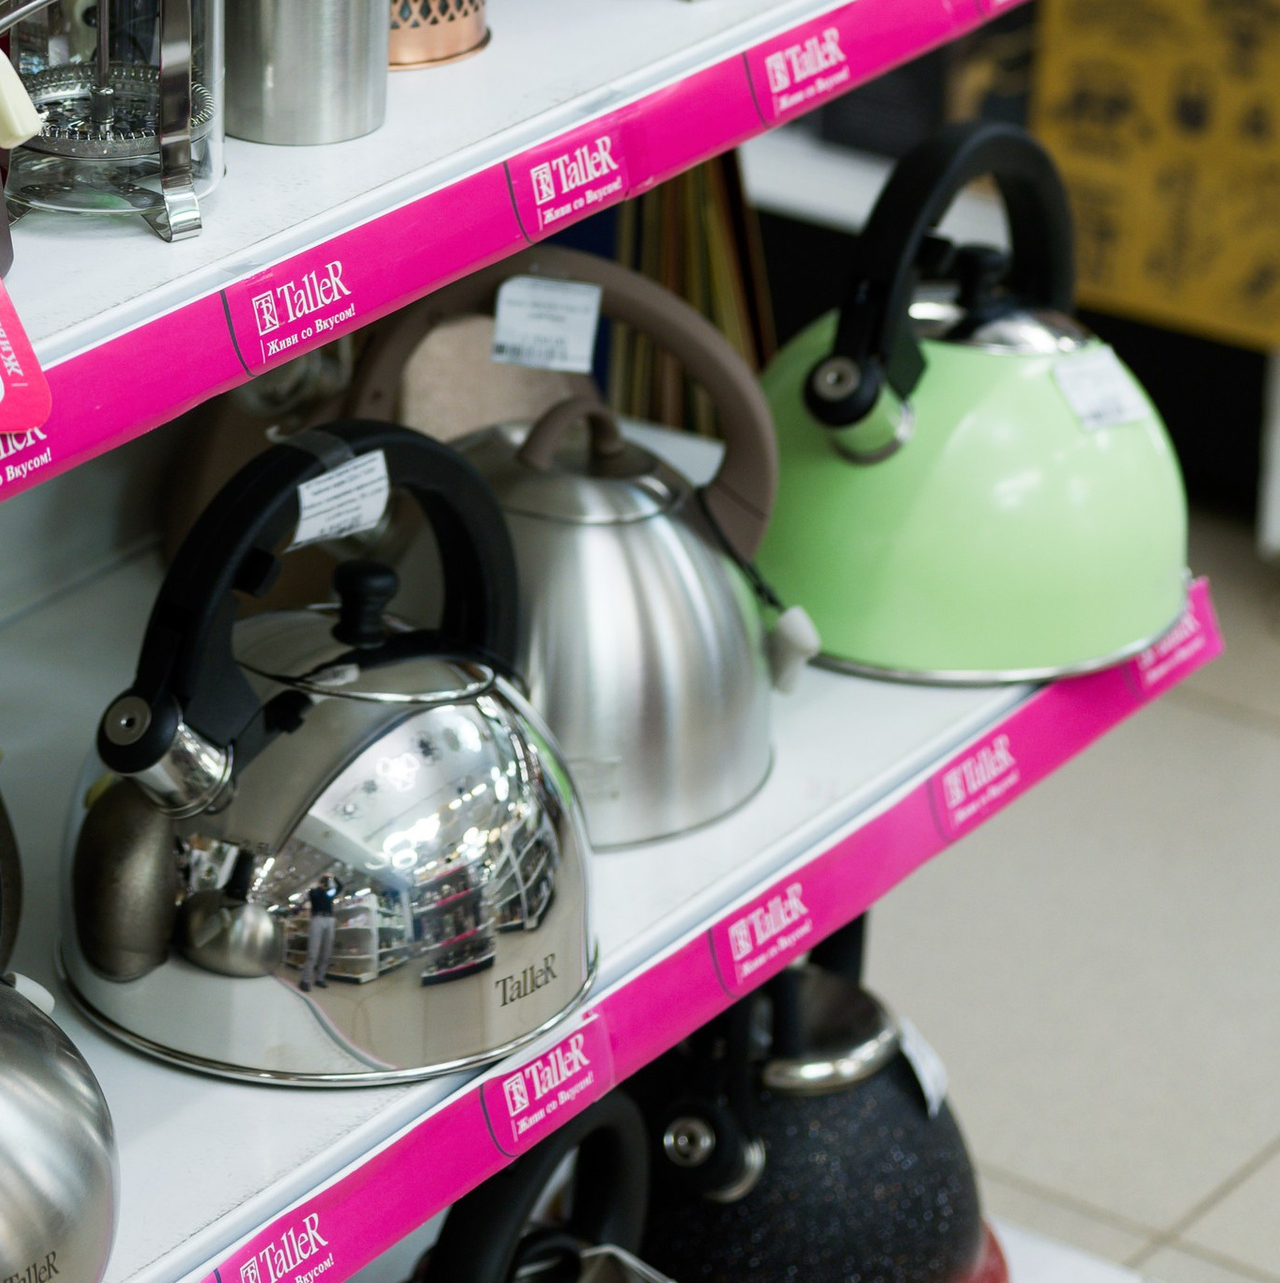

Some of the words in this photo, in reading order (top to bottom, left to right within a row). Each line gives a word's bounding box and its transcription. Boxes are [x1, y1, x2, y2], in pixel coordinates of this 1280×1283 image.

[552, 135, 618, 195] TalleR
[277, 260, 351, 323] TalleR
[267, 336, 298, 358] Живи
[300, 326, 313, 340] со
[314, 303, 356, 334] Вкусом!
[6, 447, 52, 483] Вкусом!
[495, 953, 558, 1007] TalleR
[524, 1033, 590, 1101] TalleR
[260, 1212, 328, 1282] TalleR
